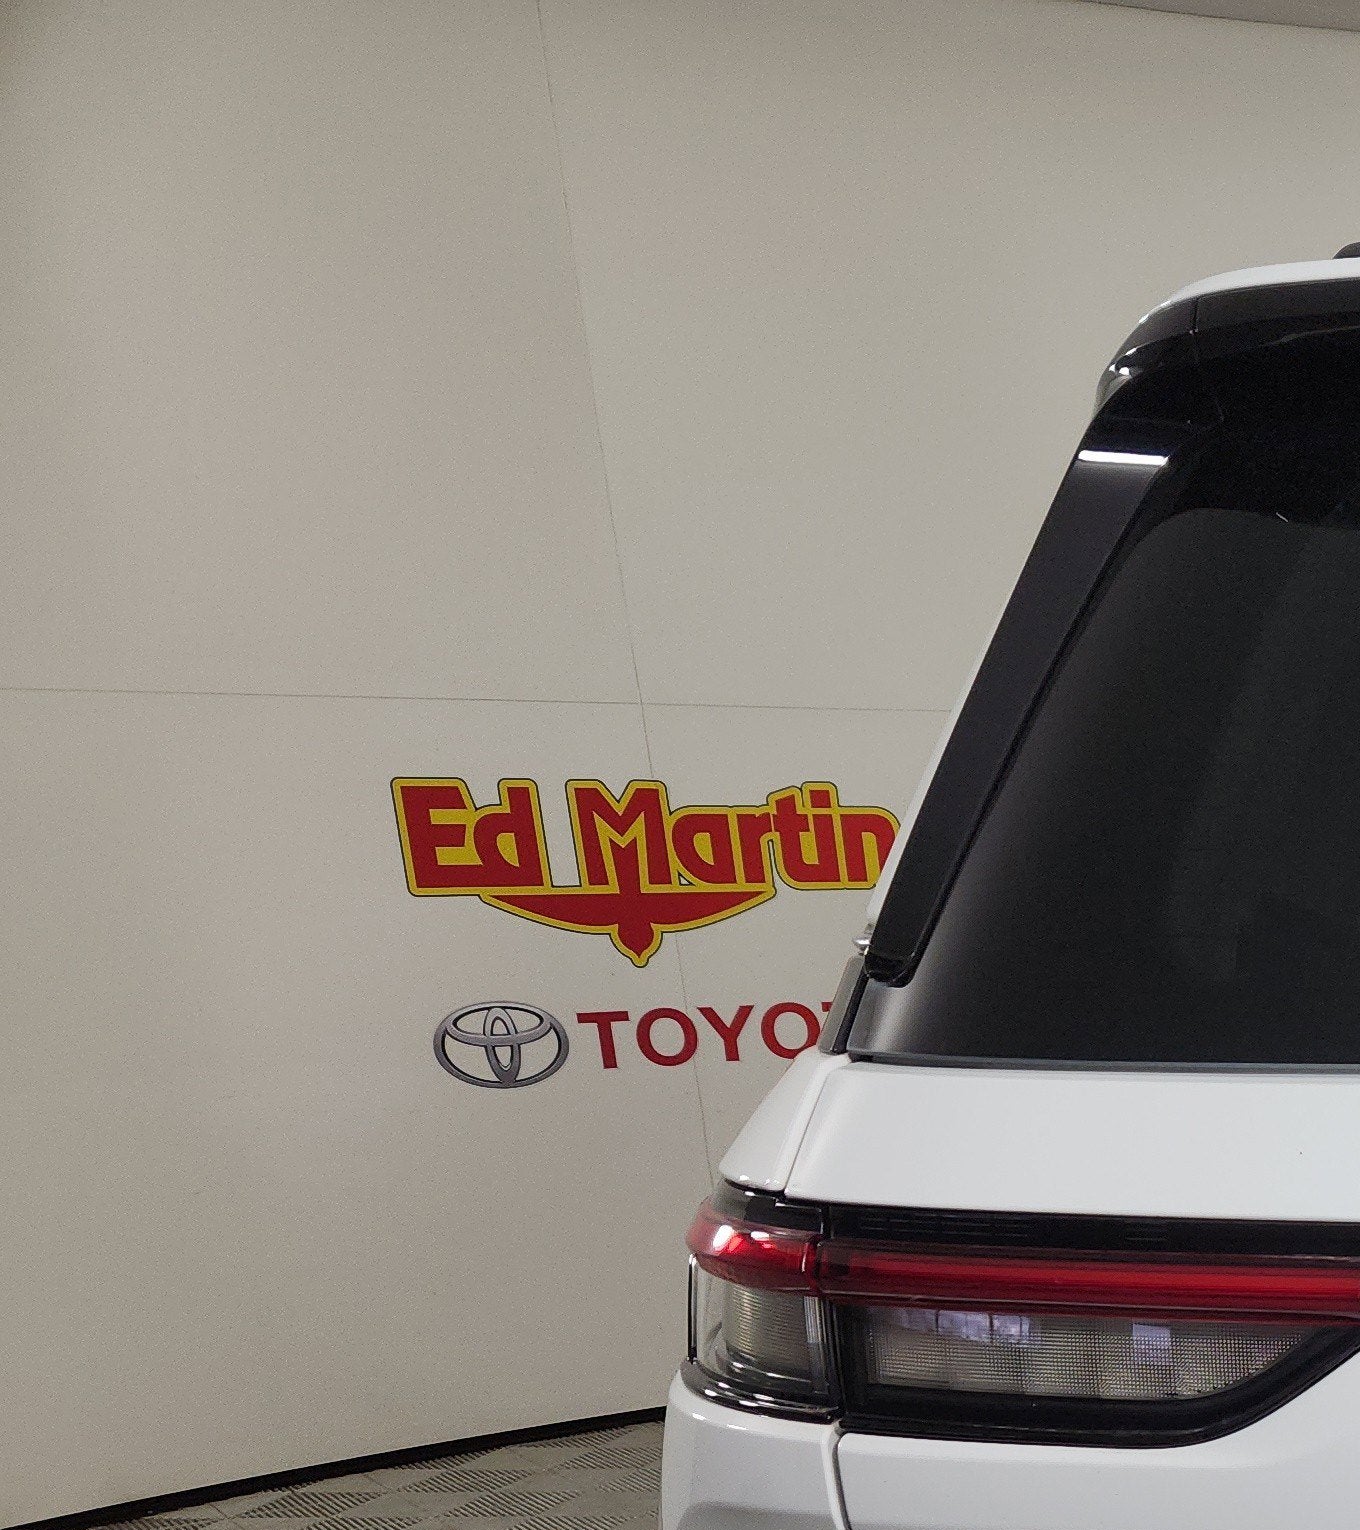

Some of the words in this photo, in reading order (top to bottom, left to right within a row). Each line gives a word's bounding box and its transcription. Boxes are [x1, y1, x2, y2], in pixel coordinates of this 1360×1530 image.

[391, 777, 552, 896] Ed
[565, 779, 901, 890] Martin
[576, 1001, 834, 1069] TOYO
